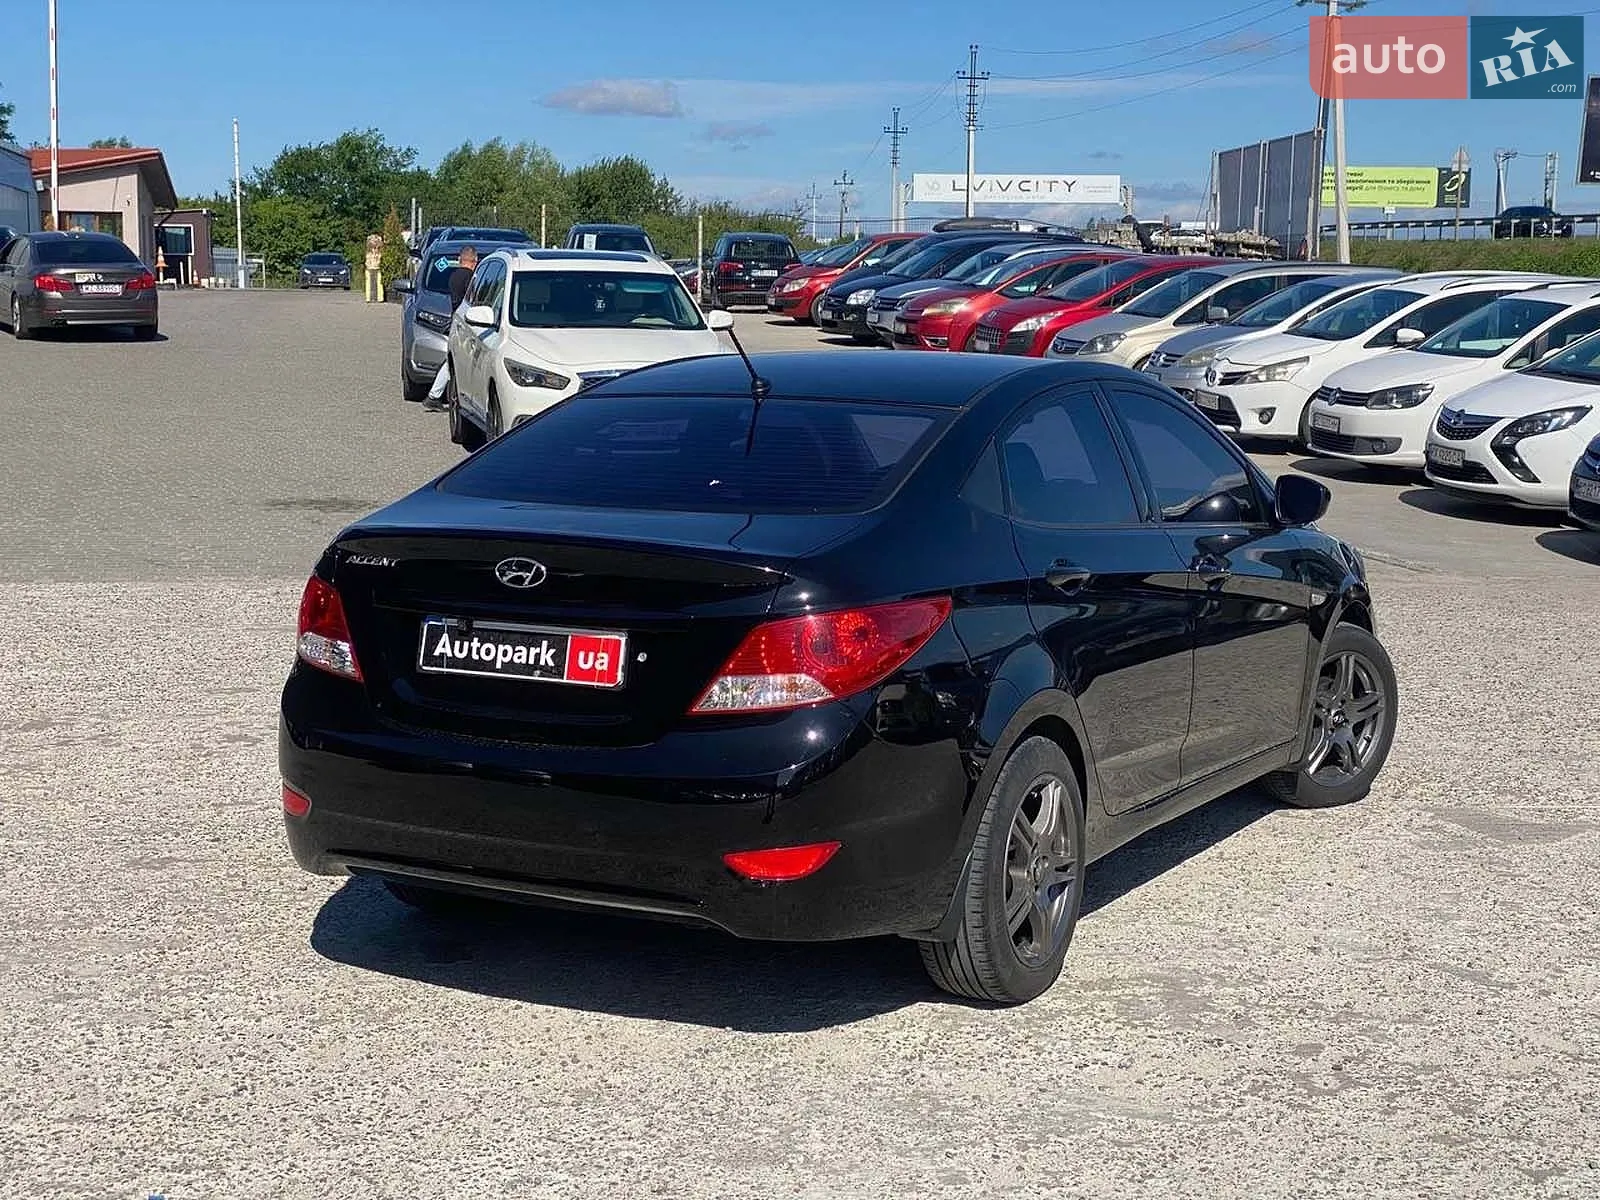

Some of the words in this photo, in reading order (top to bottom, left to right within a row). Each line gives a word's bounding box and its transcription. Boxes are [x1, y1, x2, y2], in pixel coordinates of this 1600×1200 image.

[345, 555, 401, 568] ACCENT
[433, 632, 557, 669] Autopark
[577, 649, 609, 671] ua
